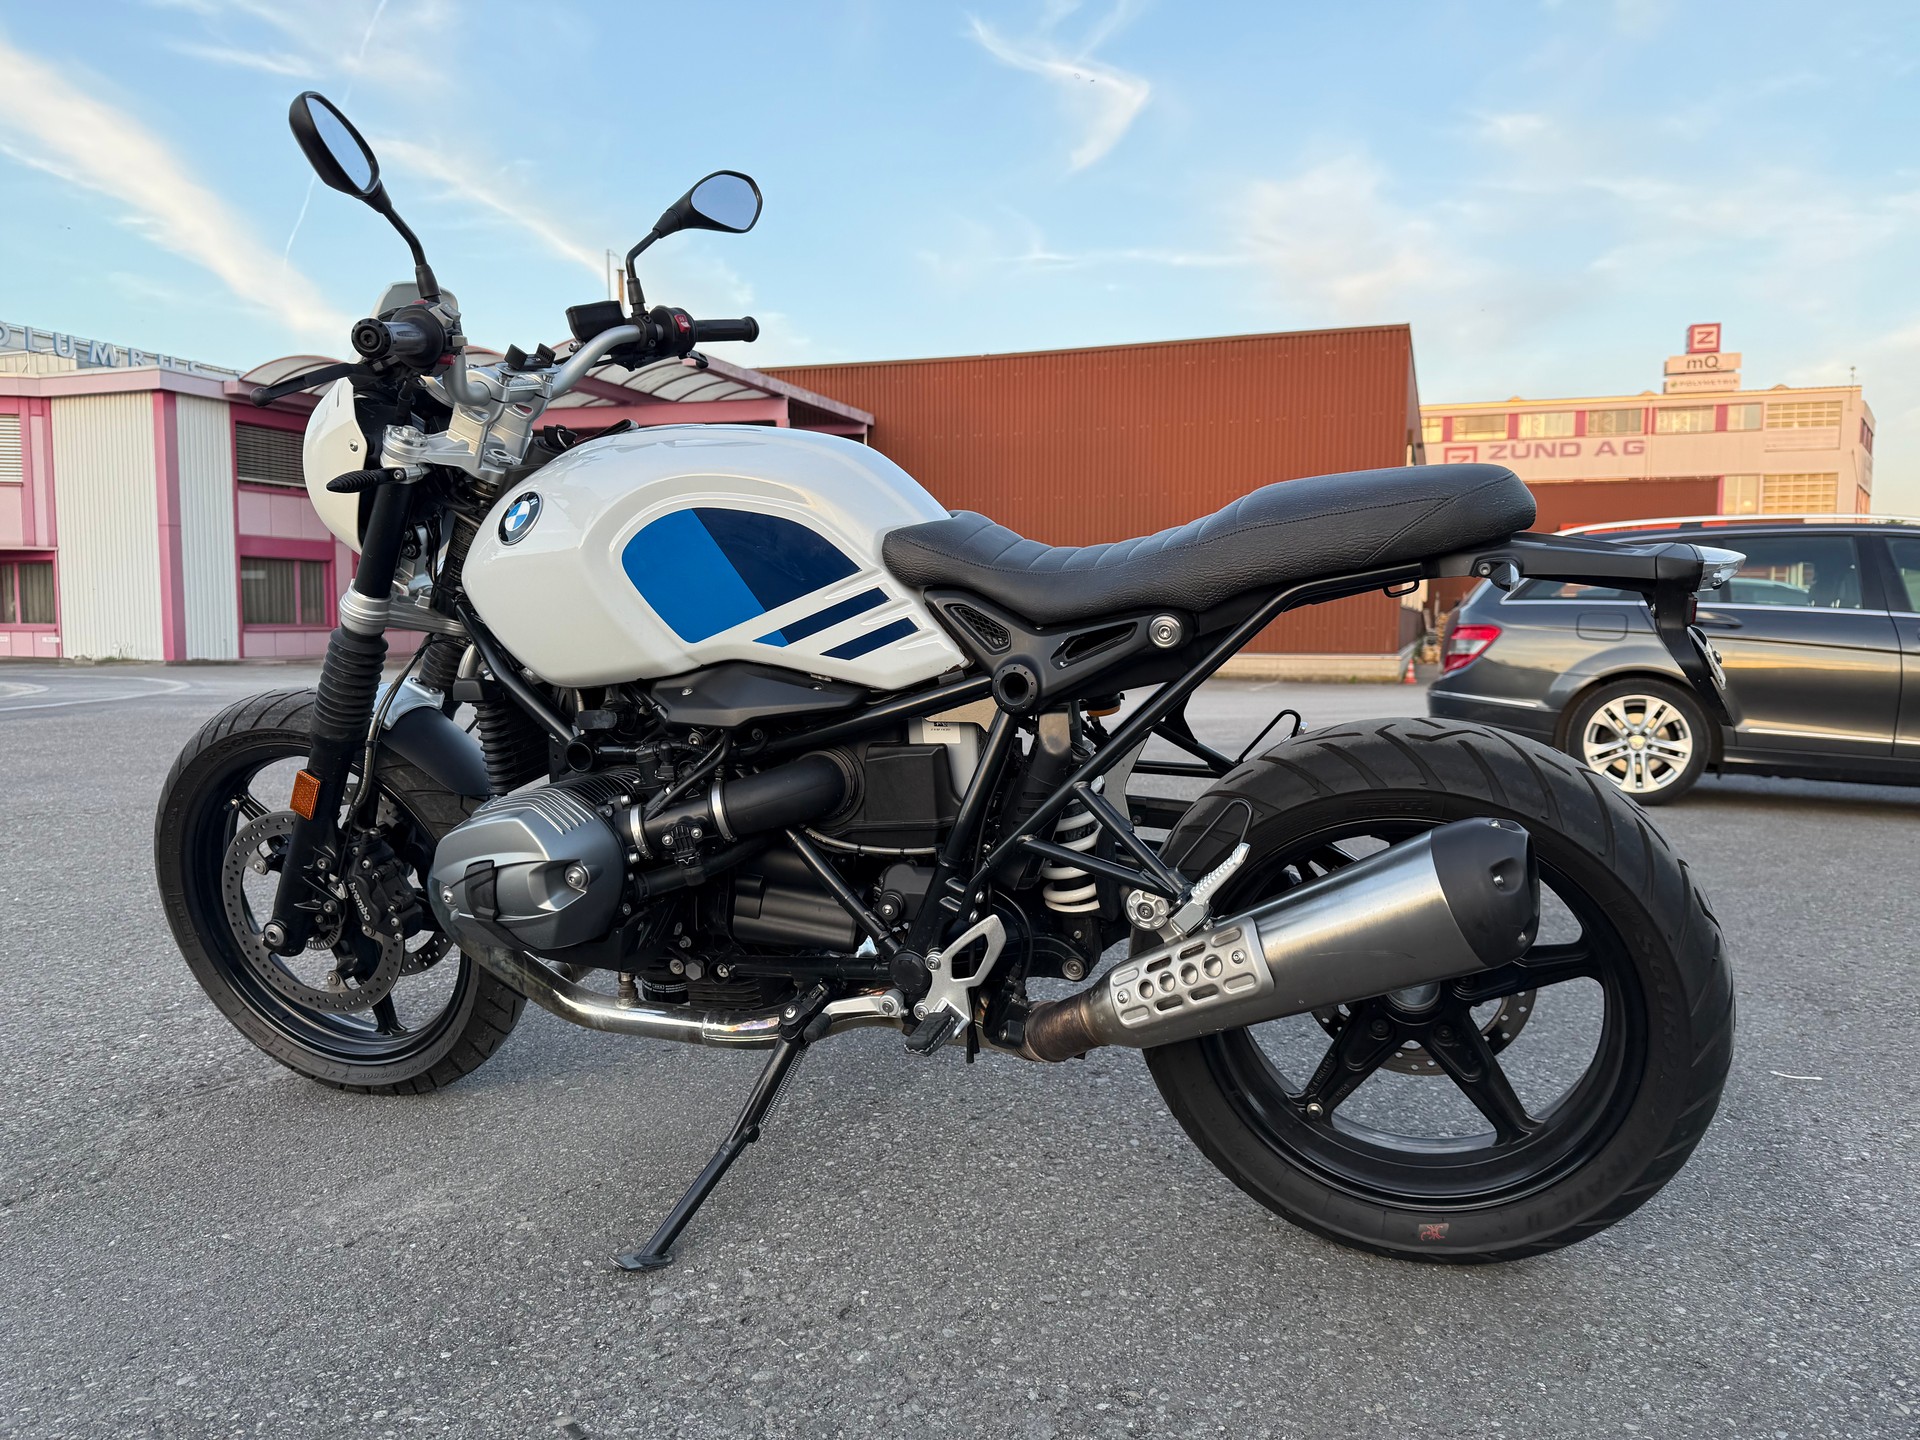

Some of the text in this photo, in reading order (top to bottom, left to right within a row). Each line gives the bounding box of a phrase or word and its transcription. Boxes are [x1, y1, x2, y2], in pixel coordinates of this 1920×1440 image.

[1686, 355, 1719, 370] mQ
[1488, 440, 1646, 460] ZÜND AG
[347, 882, 371, 921] brembo
